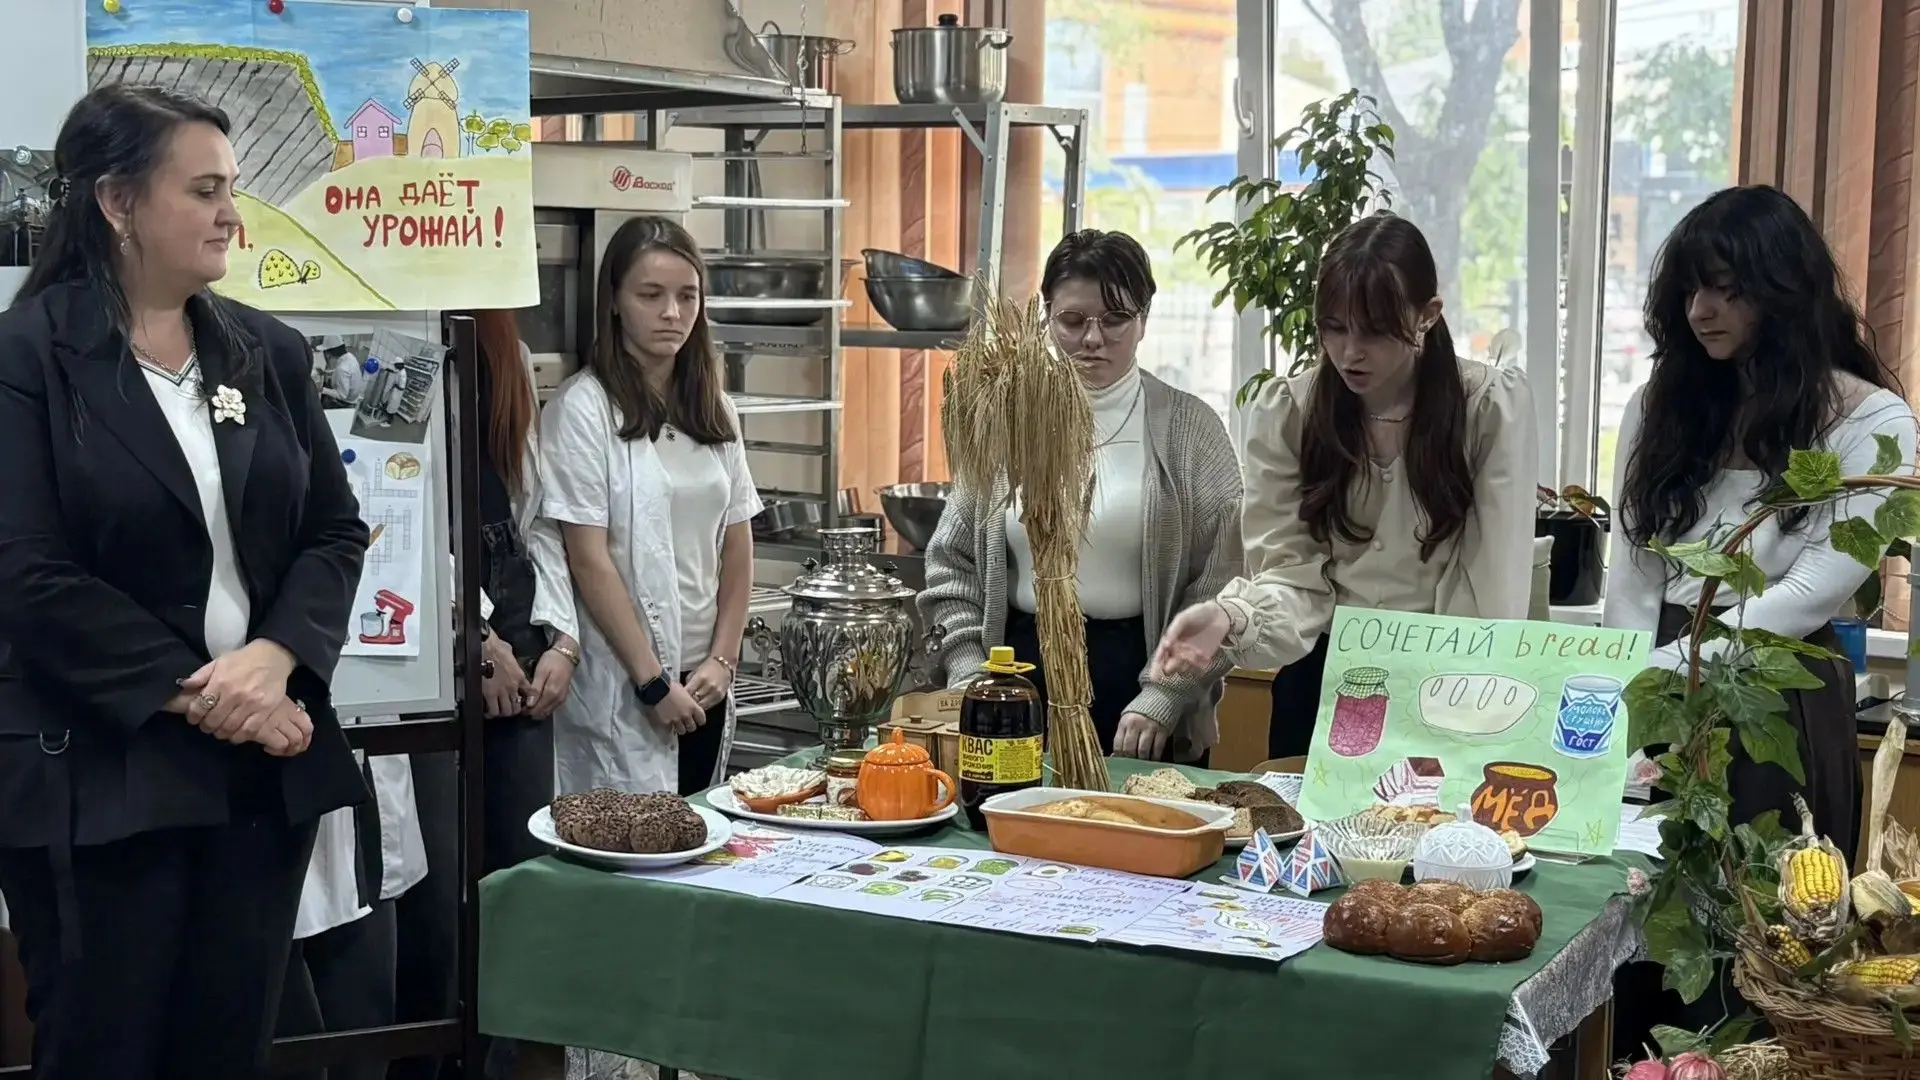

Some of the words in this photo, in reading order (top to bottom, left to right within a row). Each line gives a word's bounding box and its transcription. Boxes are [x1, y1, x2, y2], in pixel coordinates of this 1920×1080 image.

[325, 185, 382, 215] ОНА
[398, 172, 480, 207] ДАЁТ
[1337, 617, 1495, 659] СОЧЕТАЙ
[1514, 628, 1638, 661] bread!
[962, 736, 994, 756] КВАС
[1568, 735, 1597, 748] ГОСТ
[1472, 785, 1555, 830] МЁД
